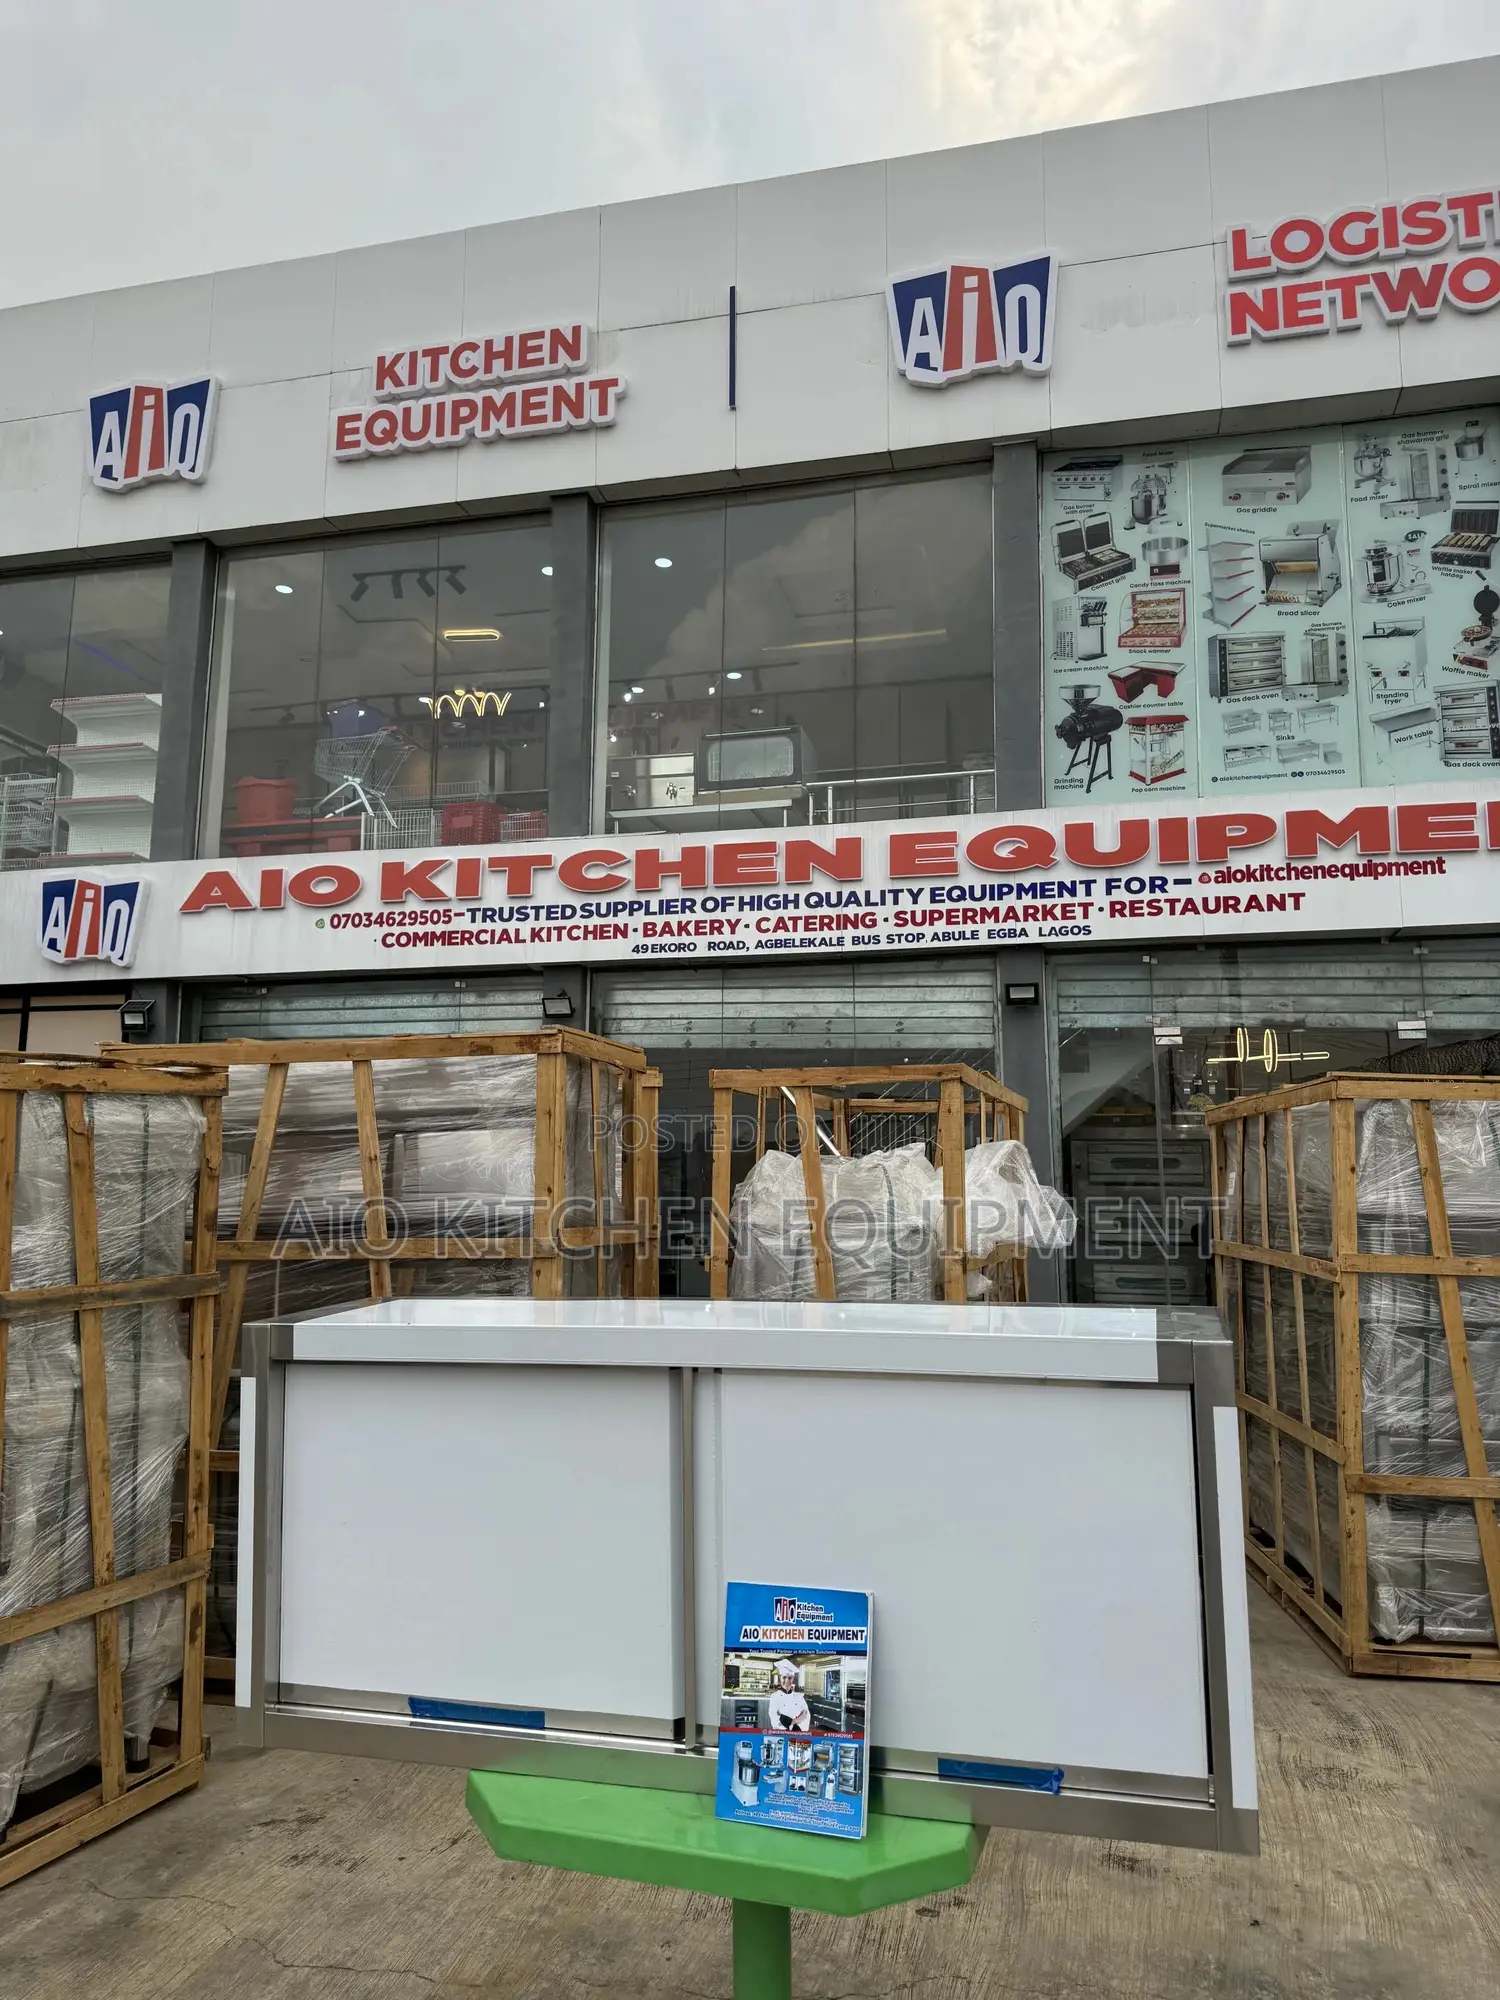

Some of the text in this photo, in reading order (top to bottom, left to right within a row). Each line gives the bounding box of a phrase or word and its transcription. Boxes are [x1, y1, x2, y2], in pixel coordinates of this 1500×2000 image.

[1231, 190, 1500, 275] LOGIST
[1230, 256, 1500, 337] NETWO
[375, 325, 583, 391] KITCHEN
[335, 378, 619, 450] EQUIPMENT
[1397, 436, 1434, 445] shawarma
[1481, 481, 1500, 489] mixer
[1252, 505, 1277, 514] griddle
[1204, 522, 1236, 533] Supermarket
[1440, 571, 1464, 579] hotdog
[1387, 595, 1427, 608] Cake mixer
[1441, 665, 1490, 679] Waffle maker
[1242, 694, 1259, 702] deck
[1376, 691, 1409, 700] Standing
[1394, 729, 1433, 744] Work table
[1306, 769, 1346, 777] 07034629505
[1054, 777, 1084, 785] Grinding
[179, 801, 1500, 912] AIO KITCHEN EQUIPME
[579, 898, 697, 919] SUPPLIER
[700, 896, 735, 913] OF
[739, 893, 799, 912] HIGH
[804, 887, 924, 909] QUALITY
[929, 878, 1097, 904] EQUIPMENT
[1213, 856, 1446, 885] aiokitchenequipment
[381, 892, 1306, 949] COMMERCIAL KITCHEN BAKERY CATERING SUPERMARKET RESTAURANT
[707, 939, 750, 952] ROAD,
[754, 936, 845, 950] AGBELEKALE
[851, 934, 881, 946] BUS
[930, 930, 979, 942] ABULE
[988, 927, 1029, 939] EGBA
[1038, 925, 1092, 937] LAGOS
[797, 1603, 824, 1612] Kitchen
[797, 1612, 833, 1622] Equipment
[742, 1628, 866, 1642] AIO KITCHEN EQUIPMENT
